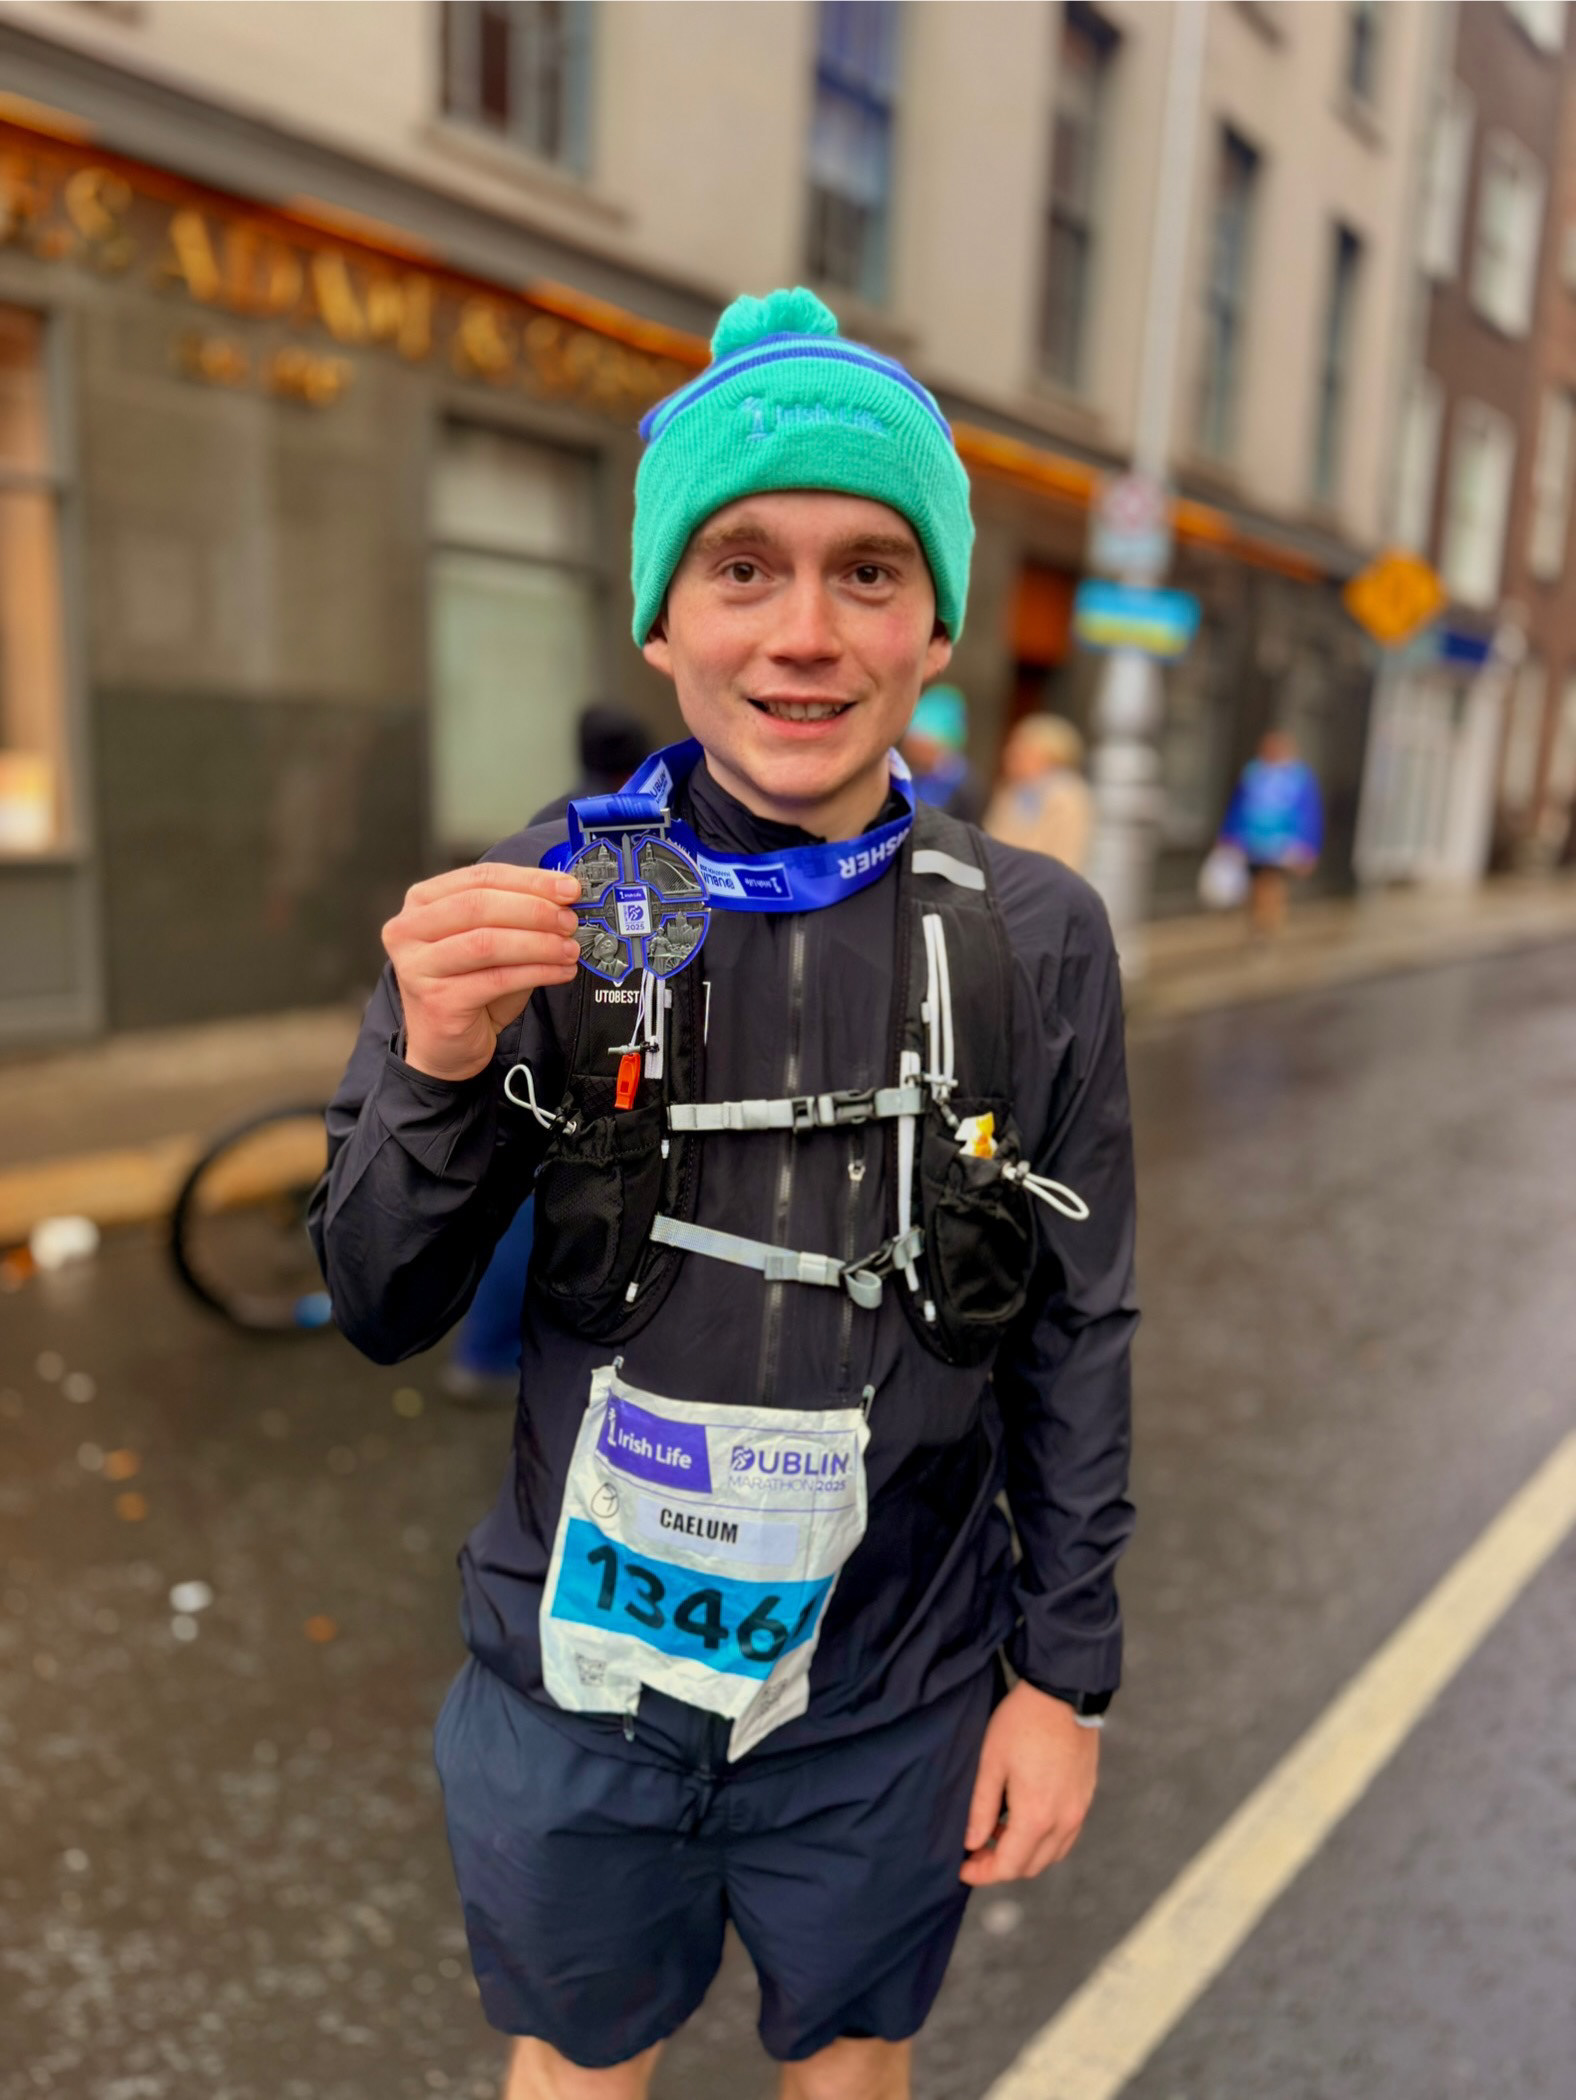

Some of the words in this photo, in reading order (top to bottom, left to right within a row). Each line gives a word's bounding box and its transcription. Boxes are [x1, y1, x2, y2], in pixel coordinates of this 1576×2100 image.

[776, 402, 831, 426] Irish
[625, 923, 646, 931] 2025
[595, 989, 640, 1004] UTOBEST
[618, 1427, 654, 1459] Irish
[655, 1442, 692, 1470] Life
[730, 1444, 850, 1477] DUBLIN
[727, 1474, 814, 1493] MARATHON
[815, 1479, 847, 1493] 2025
[659, 1507, 739, 1545] CAELUM
